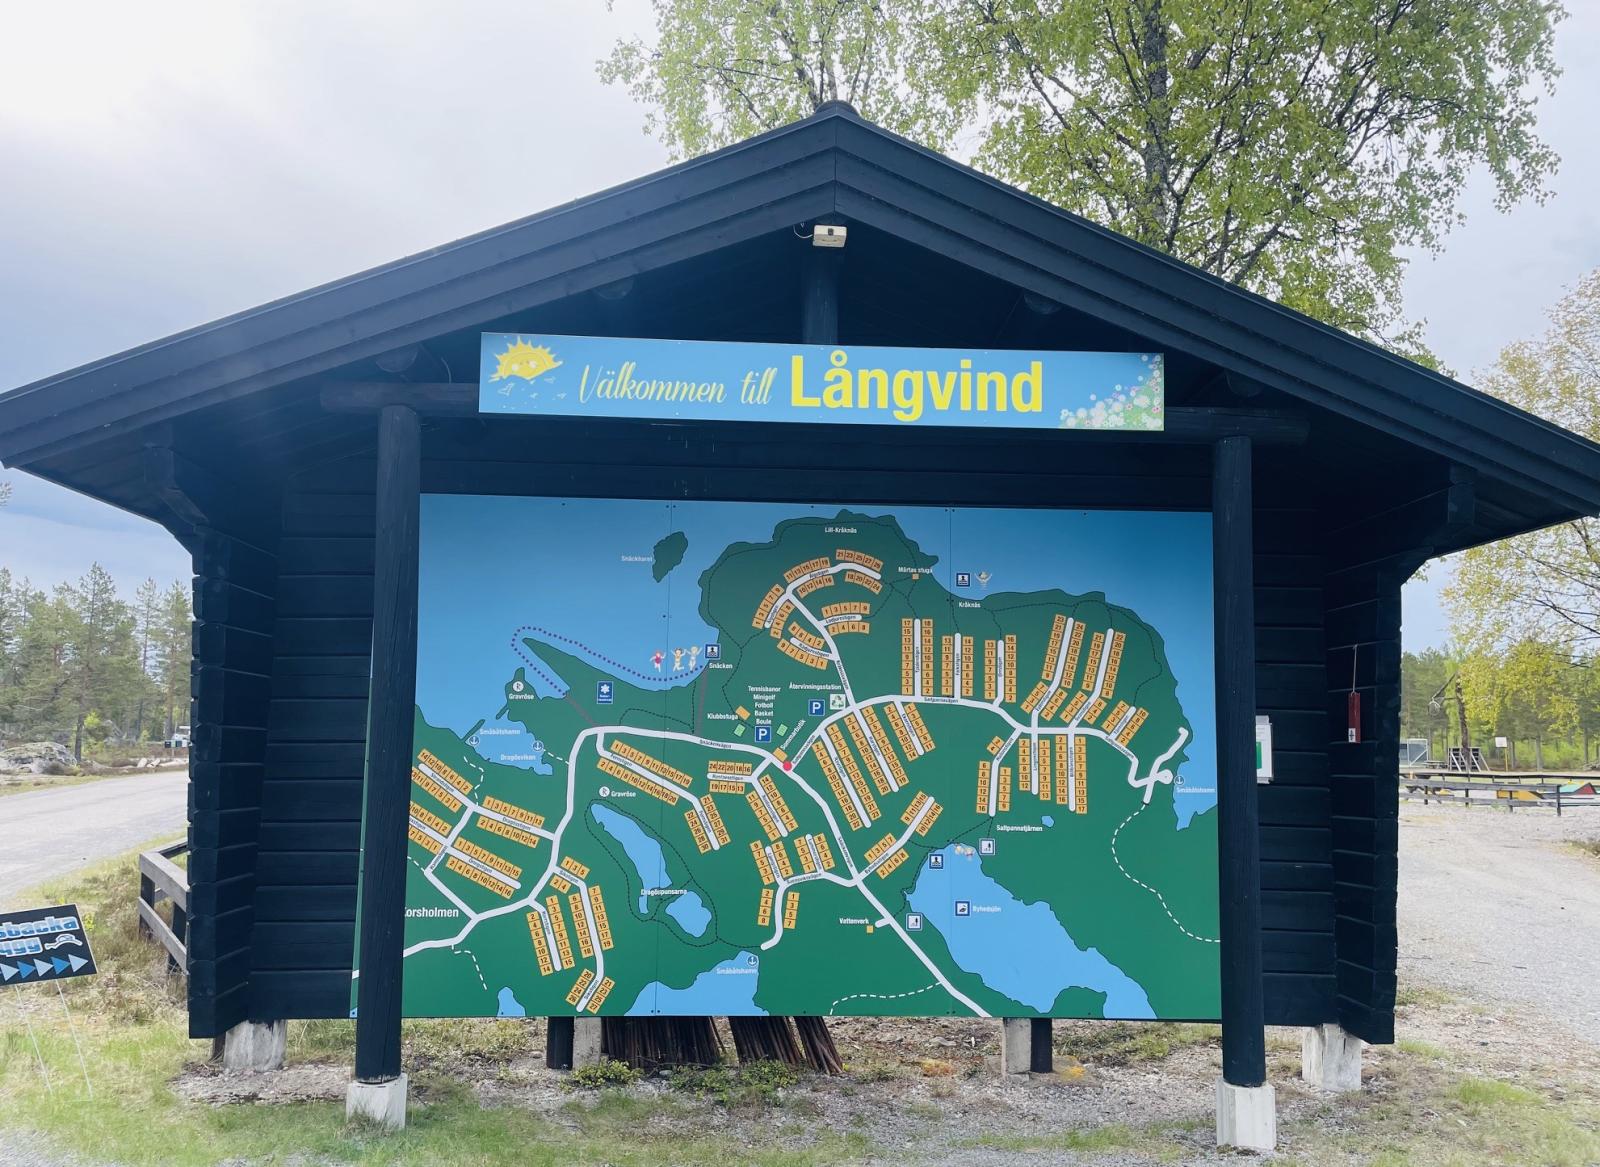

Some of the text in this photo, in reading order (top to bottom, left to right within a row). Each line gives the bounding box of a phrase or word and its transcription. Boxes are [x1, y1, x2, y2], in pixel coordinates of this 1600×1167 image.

[579, 348, 1043, 422] Välkommen till Långvind
[788, 681, 842, 691] Återvinningsstation
[753, 694, 776, 702] Minigolf
